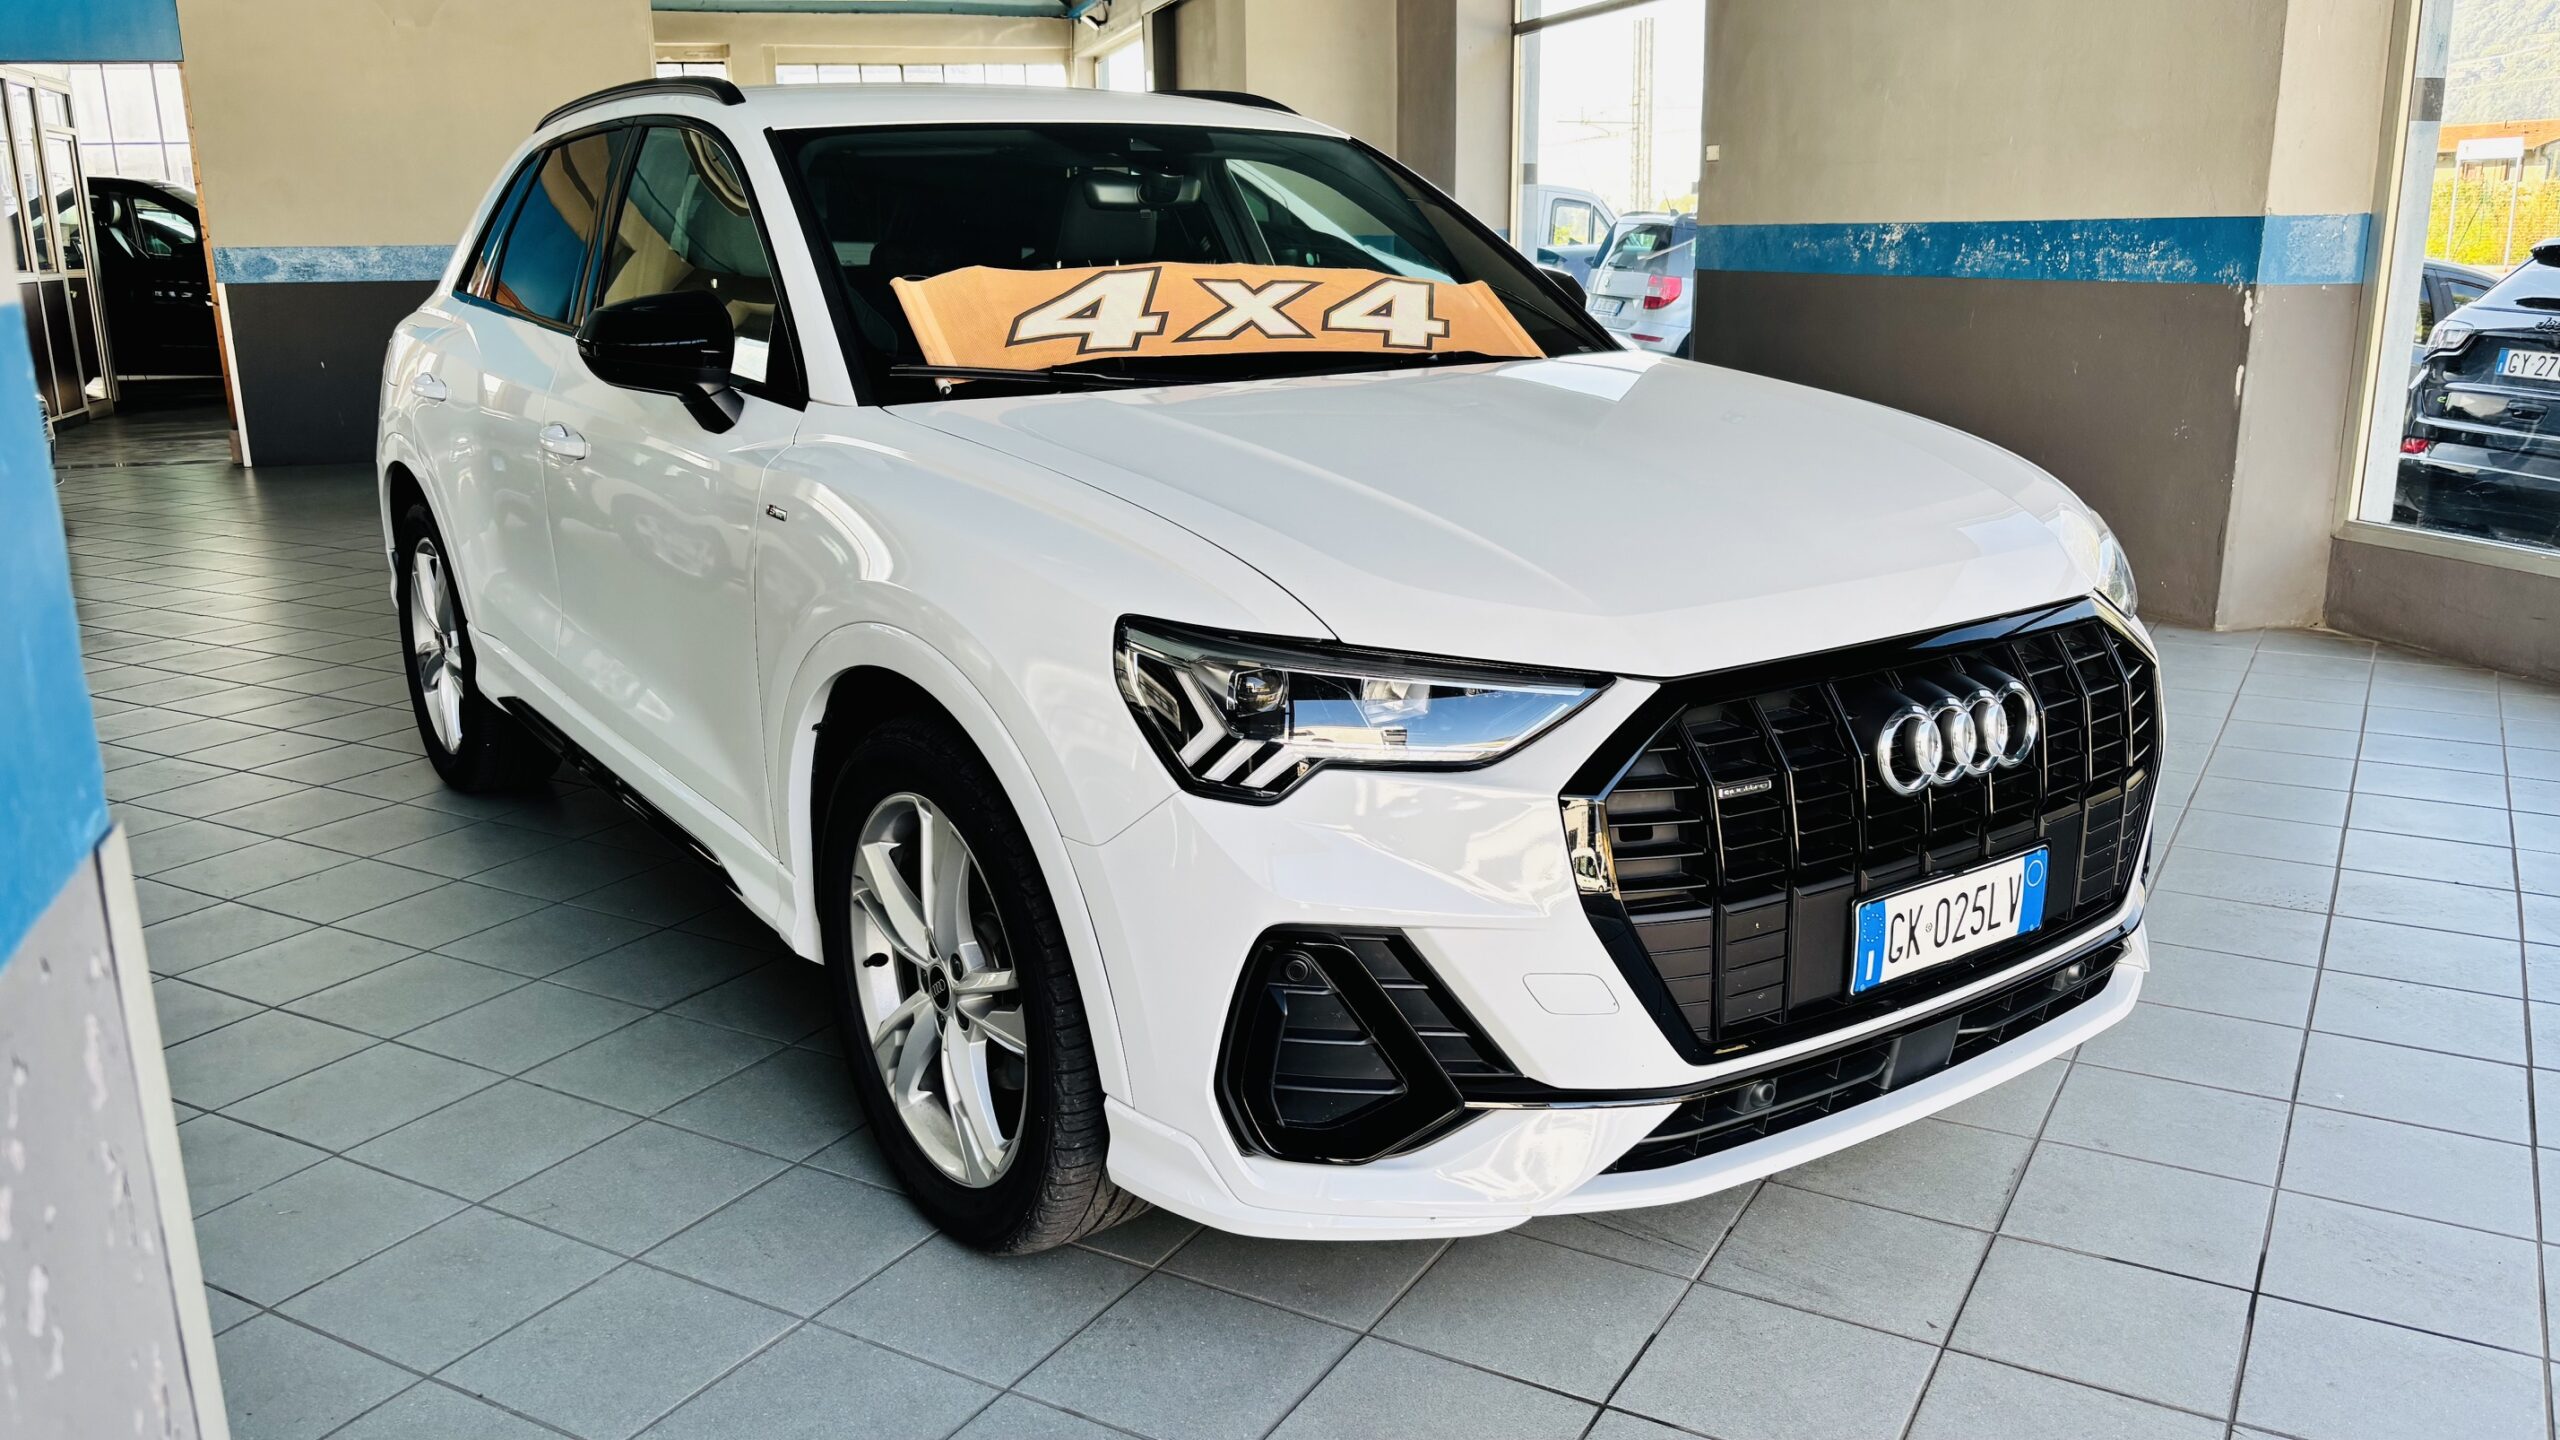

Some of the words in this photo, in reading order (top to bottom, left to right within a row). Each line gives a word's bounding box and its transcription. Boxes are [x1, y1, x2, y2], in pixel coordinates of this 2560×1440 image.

[2508, 353, 2531, 375] GY
[2534, 355, 2560, 378] 27
[1888, 904, 1924, 964] GK
